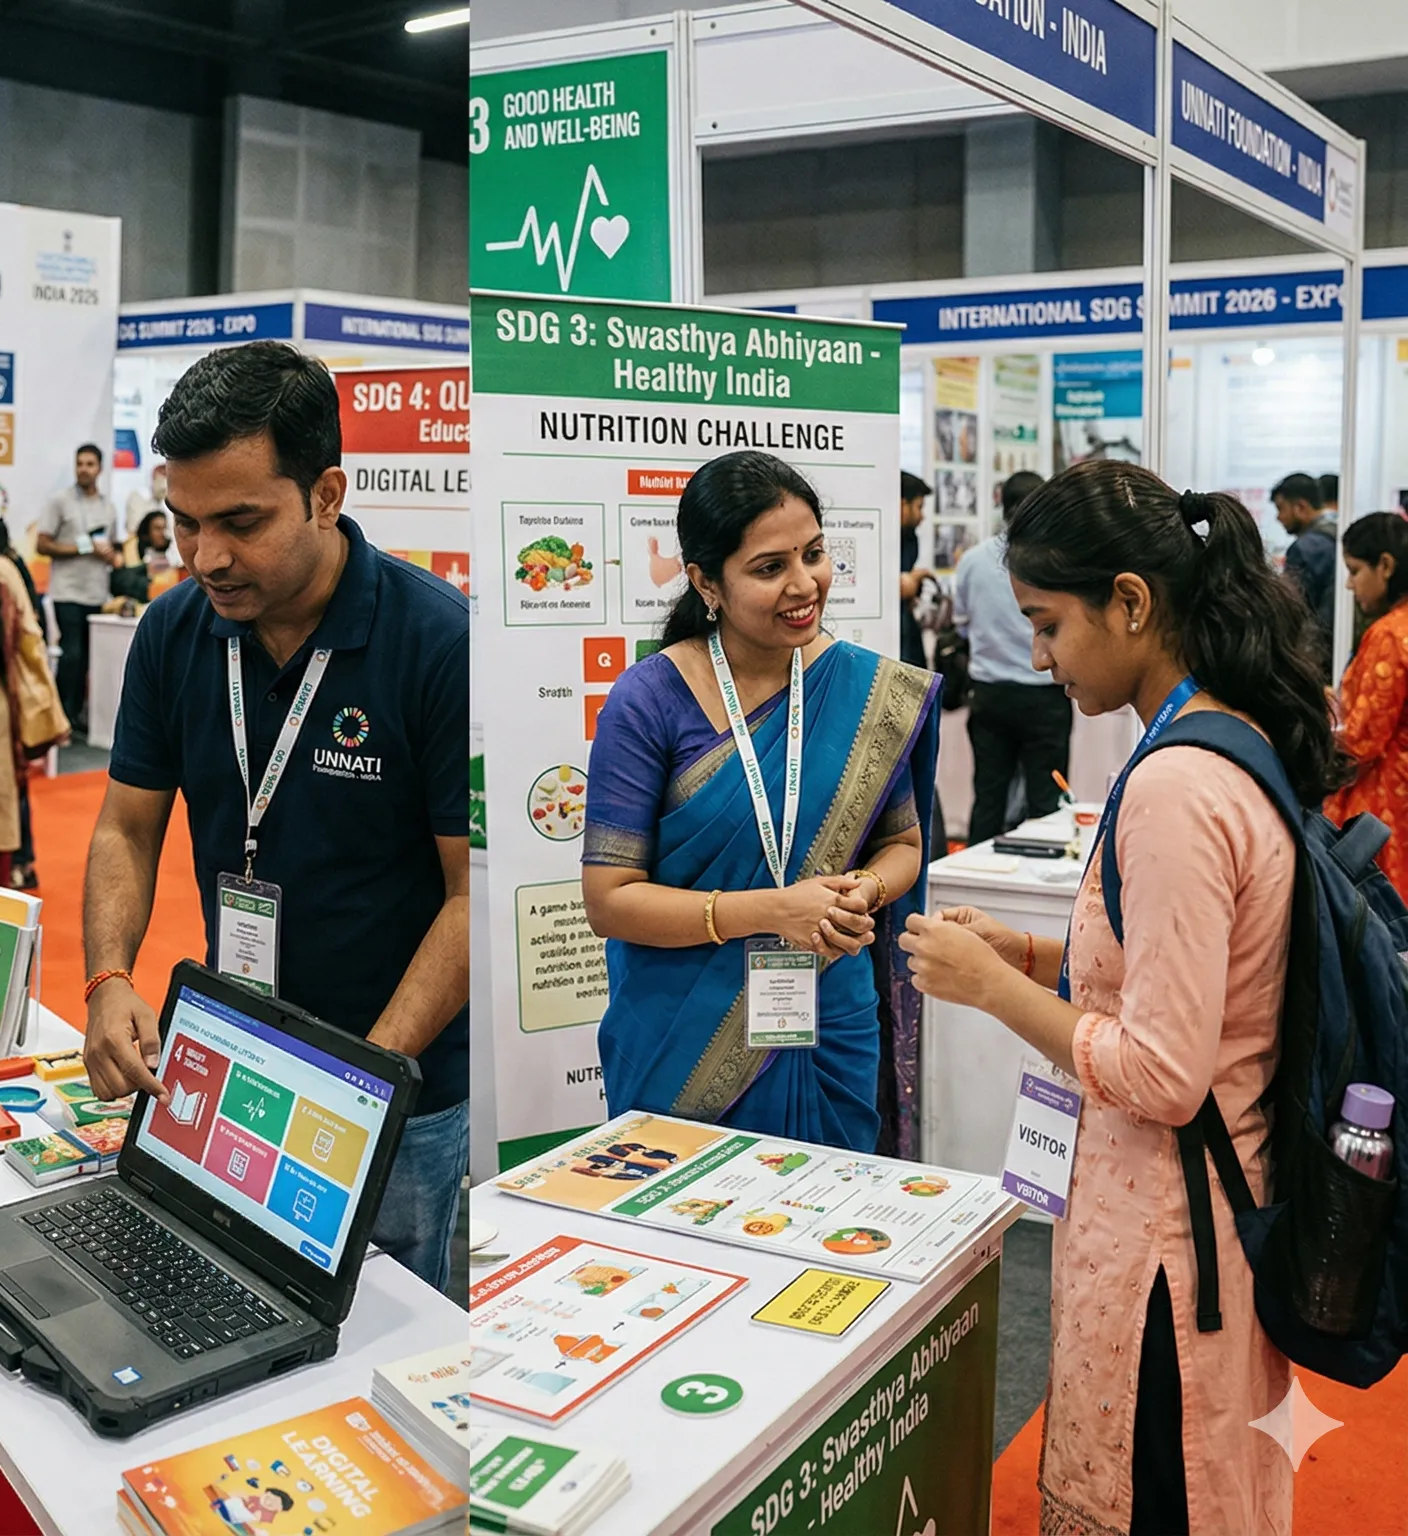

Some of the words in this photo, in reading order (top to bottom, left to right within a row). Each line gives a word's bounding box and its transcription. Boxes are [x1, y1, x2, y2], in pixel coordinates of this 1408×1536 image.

[1062, 7, 1107, 75] INDIA
[503, 89, 549, 118] GOOD
[553, 81, 615, 113] HEALTH
[1182, 79, 1225, 141] UNNATI
[470, 97, 490, 154] 3
[504, 123, 539, 151] AND
[541, 111, 640, 146] WELL-BEING
[939, 301, 1087, 331] INTERNATIONAL
[1090, 297, 1132, 322] SDG
[1225, 287, 1276, 315] 2026
[496, 308, 560, 345] SDG
[569, 312, 597, 347] 3:
[606, 316, 738, 361] Swasthya
[744, 327, 864, 368] Abhiyaan
[353, 381, 403, 412] SDG
[408, 381, 431, 411] 4:
[439, 380, 470, 412] QU
[614, 358, 718, 401] Healthy
[727, 366, 791, 399] India
[539, 411, 687, 445] NUTRITION
[697, 418, 844, 452] CHALLENGE
[356, 468, 417, 492] DIGITAL
[444, 469, 469, 493] LE
[314, 748, 382, 774] UNNATI
[530, 905, 537, 915] A
[566, 1066, 603, 1085] NUTR
[1018, 1122, 1067, 1160] VISITOR
[676, 1380, 729, 1405] 3
[751, 1479, 793, 1536] SDG
[799, 1460, 818, 1500] 3:
[822, 1373, 905, 1475] Swasthya
[909, 1302, 979, 1390] Abhiyaan
[281, 1431, 372, 1518] LEARNING
[312, 1435, 379, 1501] DIGITAL
[820, 1436, 886, 1526] Healthy
[890, 1393, 929, 1452] India
